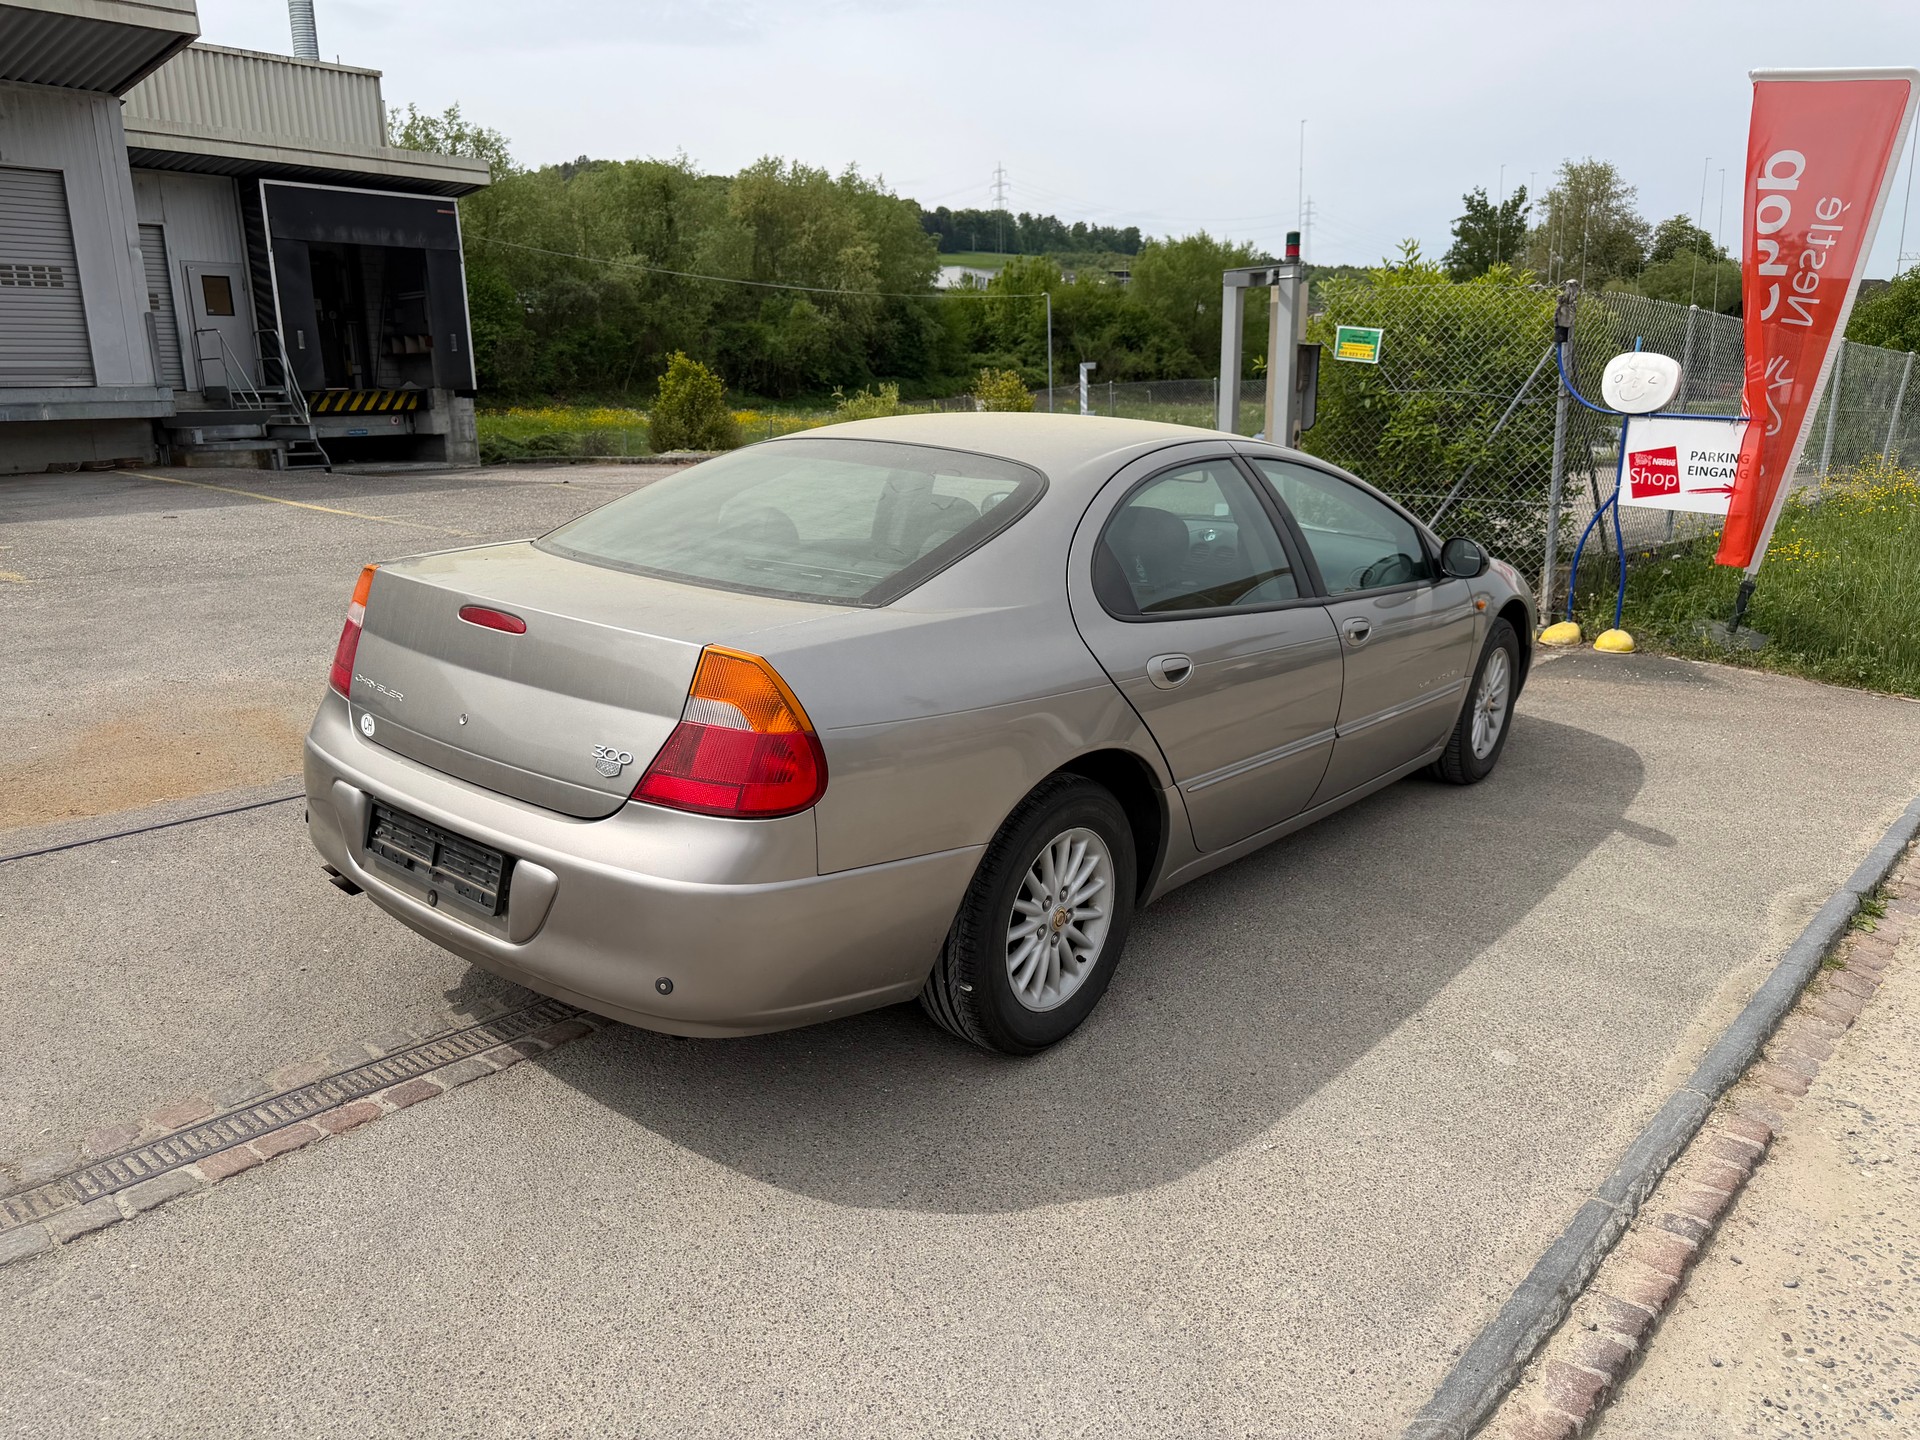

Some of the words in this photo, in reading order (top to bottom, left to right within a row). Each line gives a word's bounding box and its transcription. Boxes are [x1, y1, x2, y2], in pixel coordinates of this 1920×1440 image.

[1690, 450, 1750, 465] PARKING
[1630, 467, 1677, 490] Shop
[1687, 465, 1750, 480] EINGANG
[355, 673, 404, 702] CHRYSLER
[363, 716, 373, 733] CH
[591, 743, 633, 766] 300
